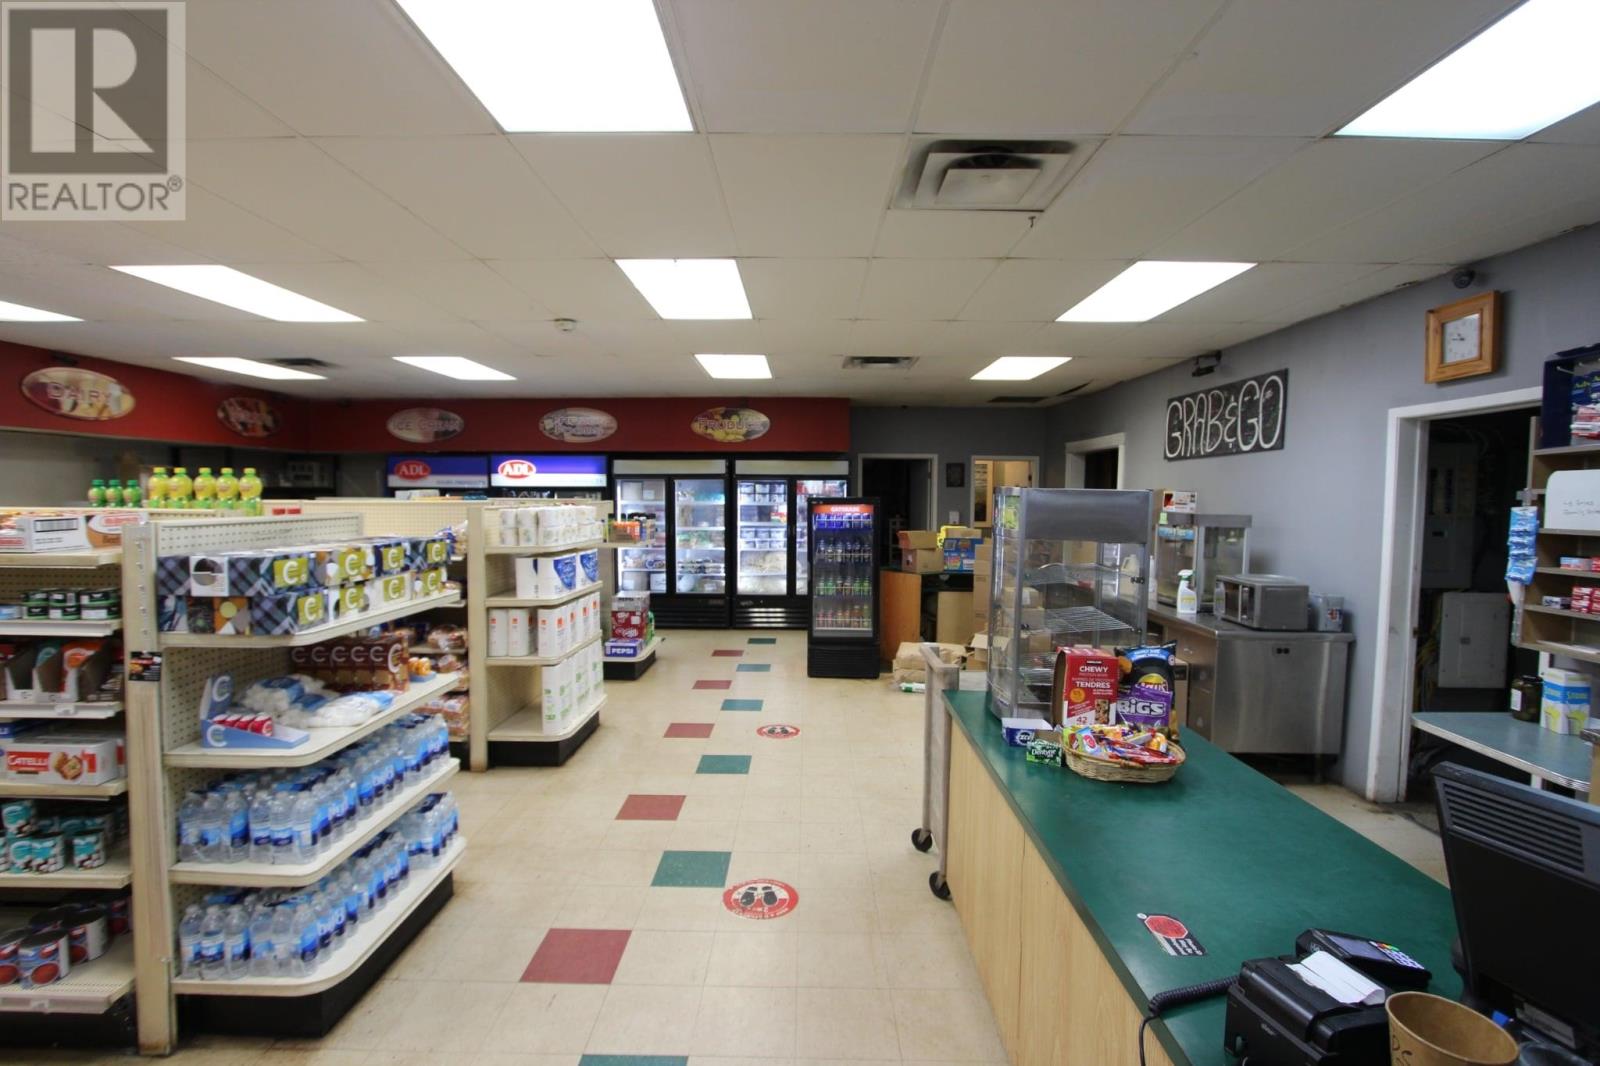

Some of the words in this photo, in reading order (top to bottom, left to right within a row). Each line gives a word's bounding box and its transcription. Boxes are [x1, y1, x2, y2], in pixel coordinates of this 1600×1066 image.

[400, 464, 427, 475] ADL
[502, 463, 531, 475] ADL
[1079, 665, 1109, 673] CHEWY
